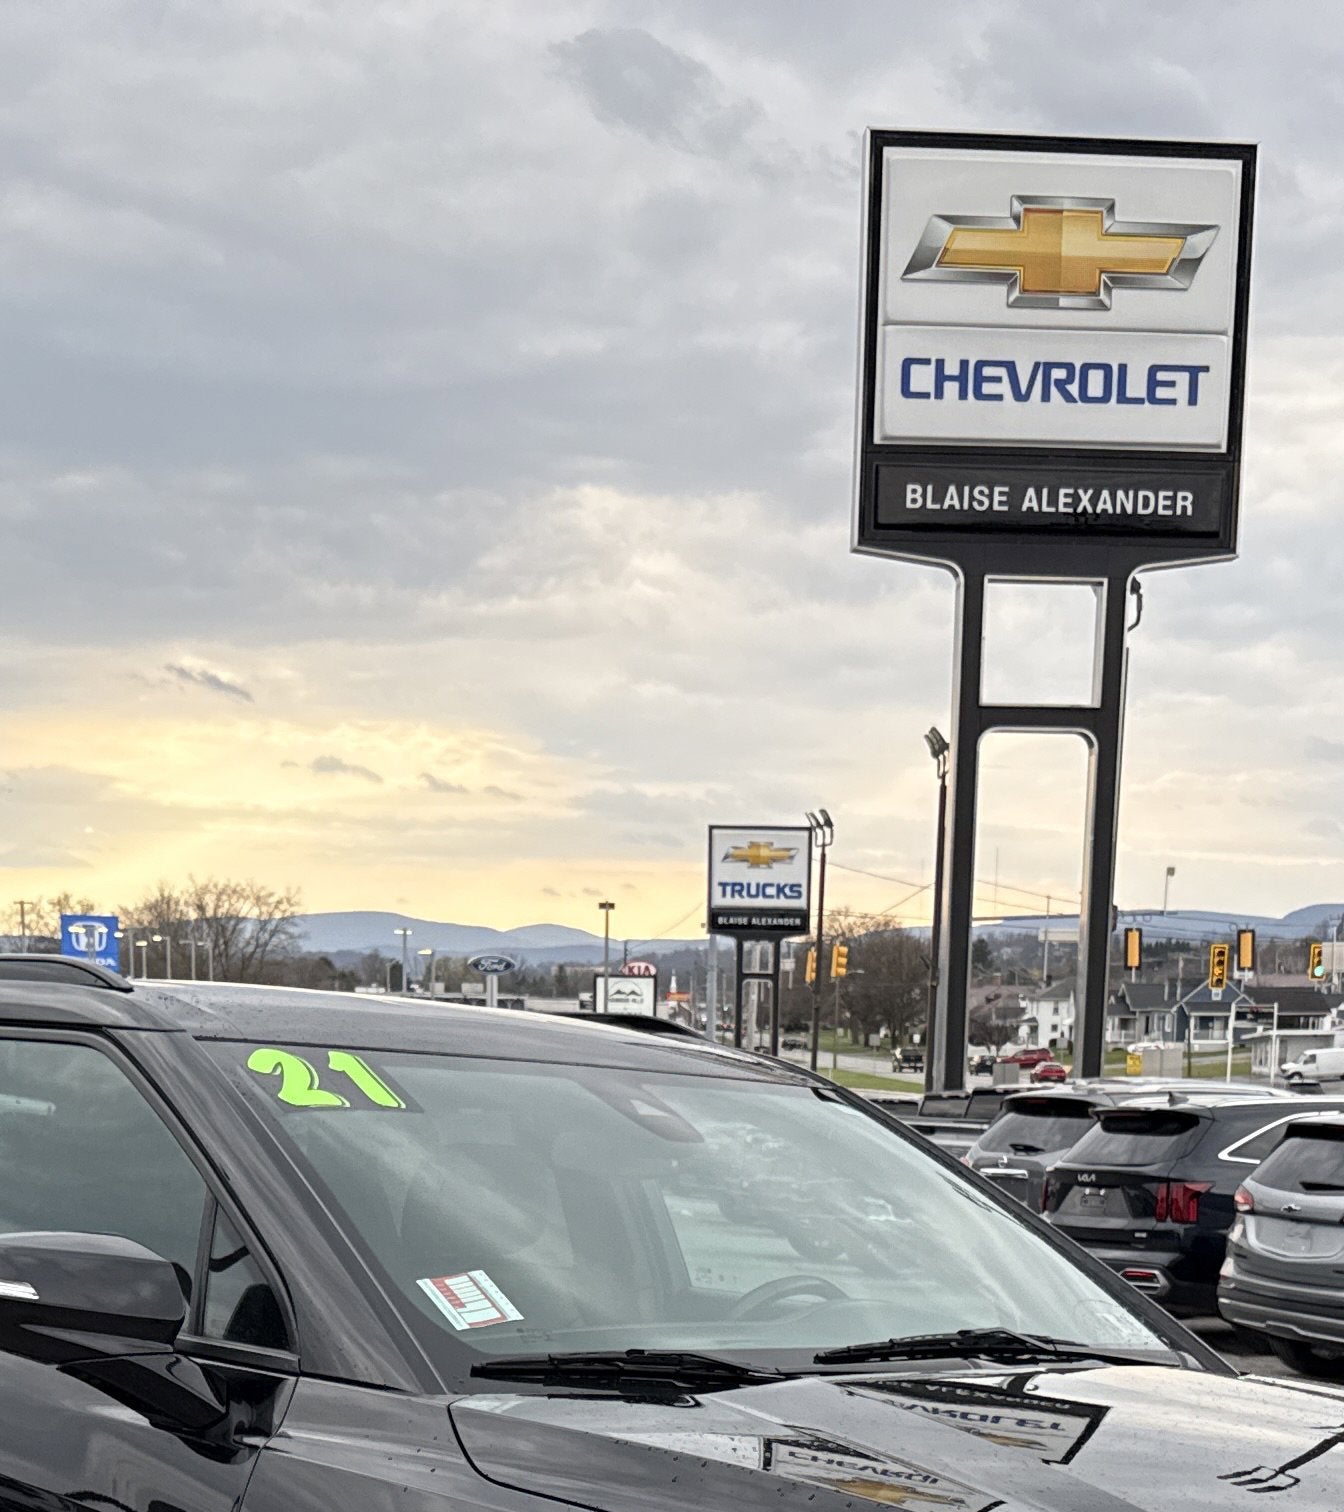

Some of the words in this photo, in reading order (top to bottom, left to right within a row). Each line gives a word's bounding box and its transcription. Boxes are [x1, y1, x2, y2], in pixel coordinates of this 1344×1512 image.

[900, 357, 1210, 406] CHEVROLET
[905, 483, 1010, 513] BLAISE
[1020, 486, 1194, 517] ALEXANDER
[717, 881, 803, 900] TRUCKS
[751, 917, 802, 926] ALEXANDER
[477, 957, 508, 972] Ford
[627, 964, 652, 976] KIA
[246, 1047, 407, 1110] 21
